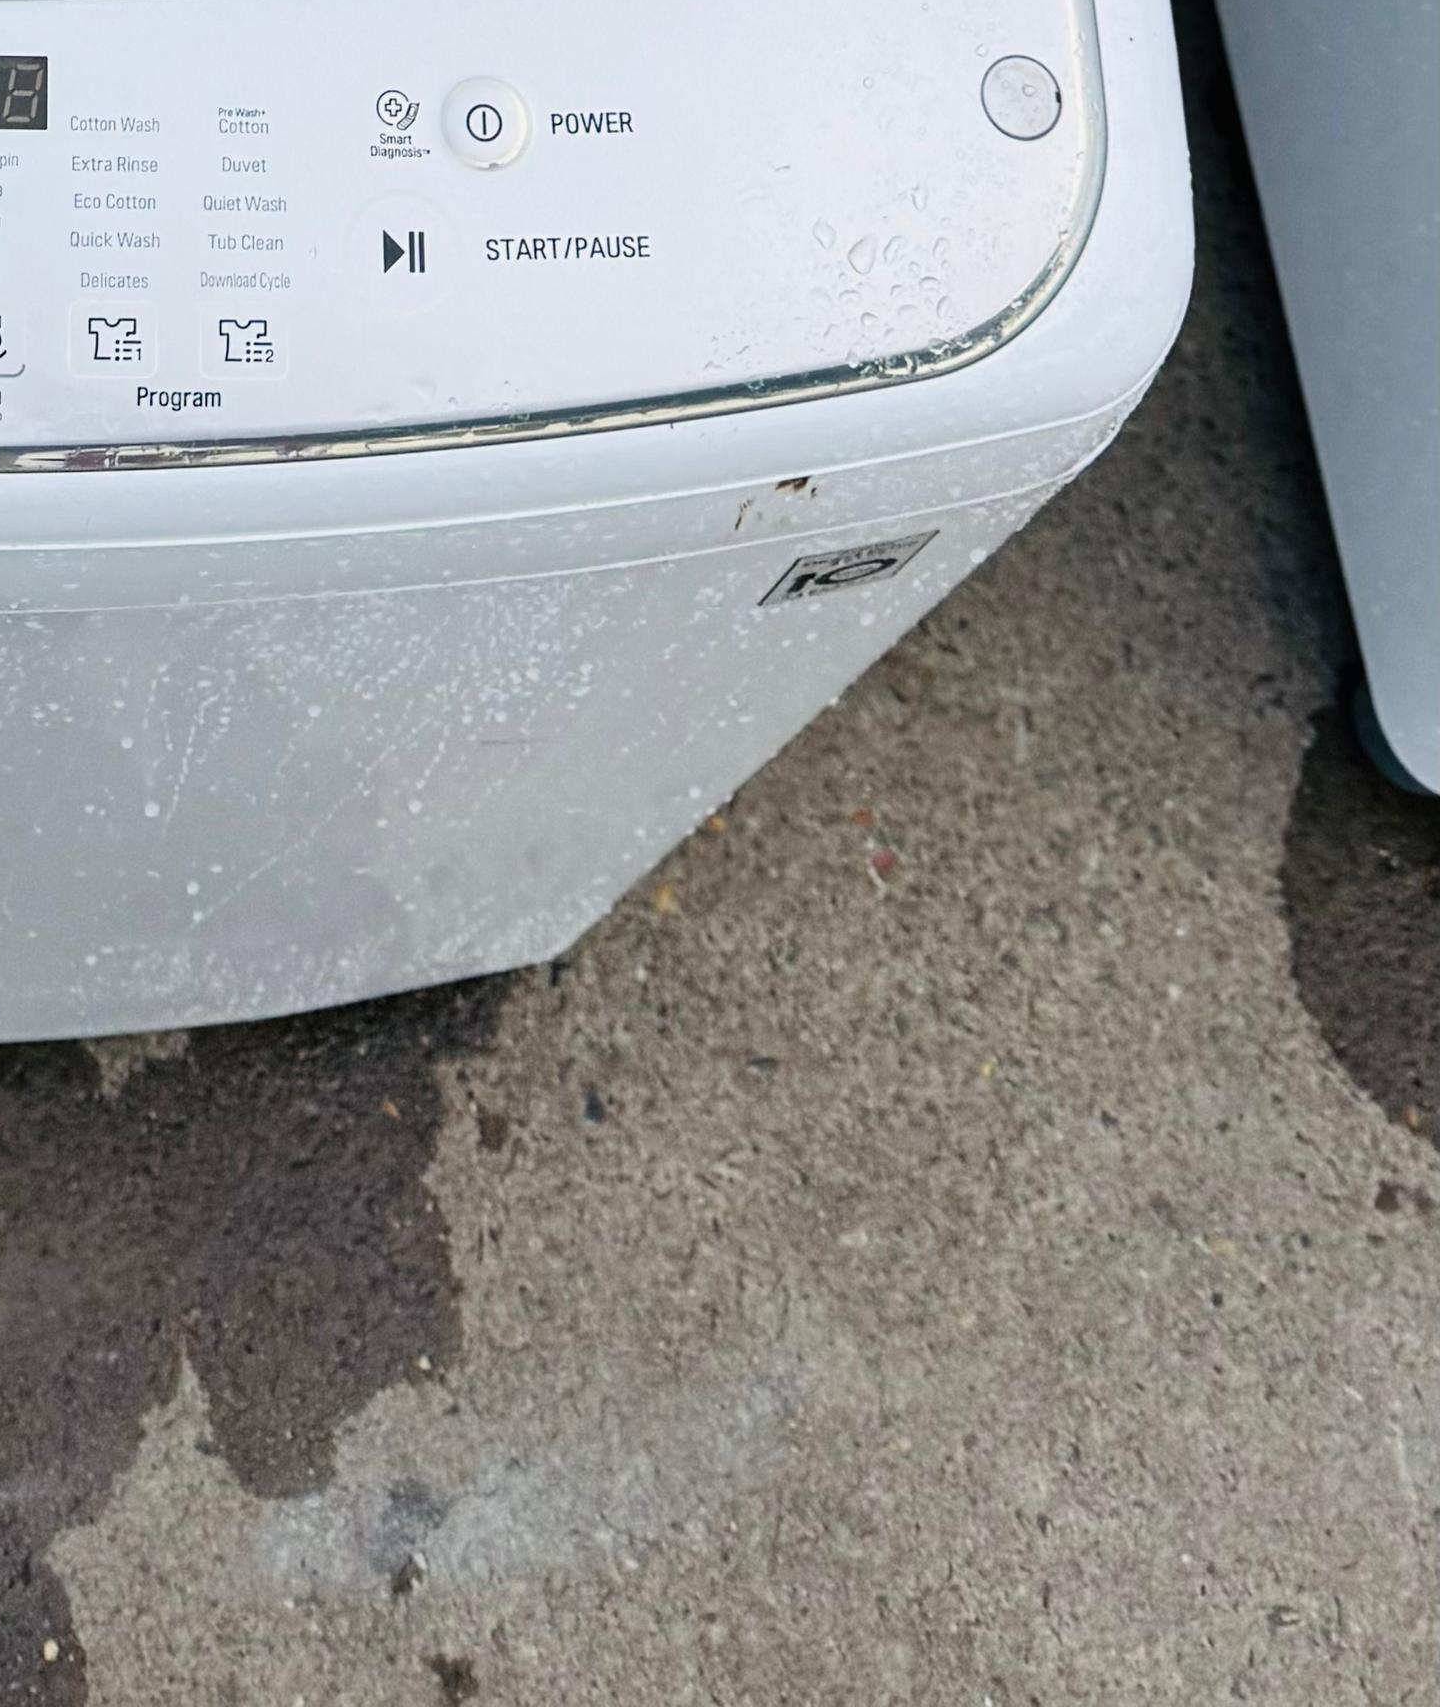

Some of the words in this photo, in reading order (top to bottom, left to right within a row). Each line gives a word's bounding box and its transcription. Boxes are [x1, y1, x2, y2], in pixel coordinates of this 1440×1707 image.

[70, 115, 117, 132] Cotton
[120, 116, 160, 133] Wash
[218, 118, 269, 135] Cotton
[550, 111, 634, 135] POWER
[379, 132, 412, 146] Smart
[71, 155, 113, 172] Extra
[117, 156, 158, 173] Rinse
[221, 156, 267, 173] Duvet
[73, 192, 102, 210] Eco
[105, 193, 156, 210] Cotton
[203, 195, 241, 212] Quiet
[244, 195, 287, 212] Wash
[69, 230, 113, 248] Quick
[116, 231, 161, 249] Wash
[207, 233, 237, 251] Tub
[241, 234, 284, 251] Clean
[485, 235, 651, 261] START/PAUSE
[80, 271, 149, 289] Delicates
[200, 271, 257, 289] Download
[259, 271, 291, 292] Cycle
[136, 386, 222, 412] Program
